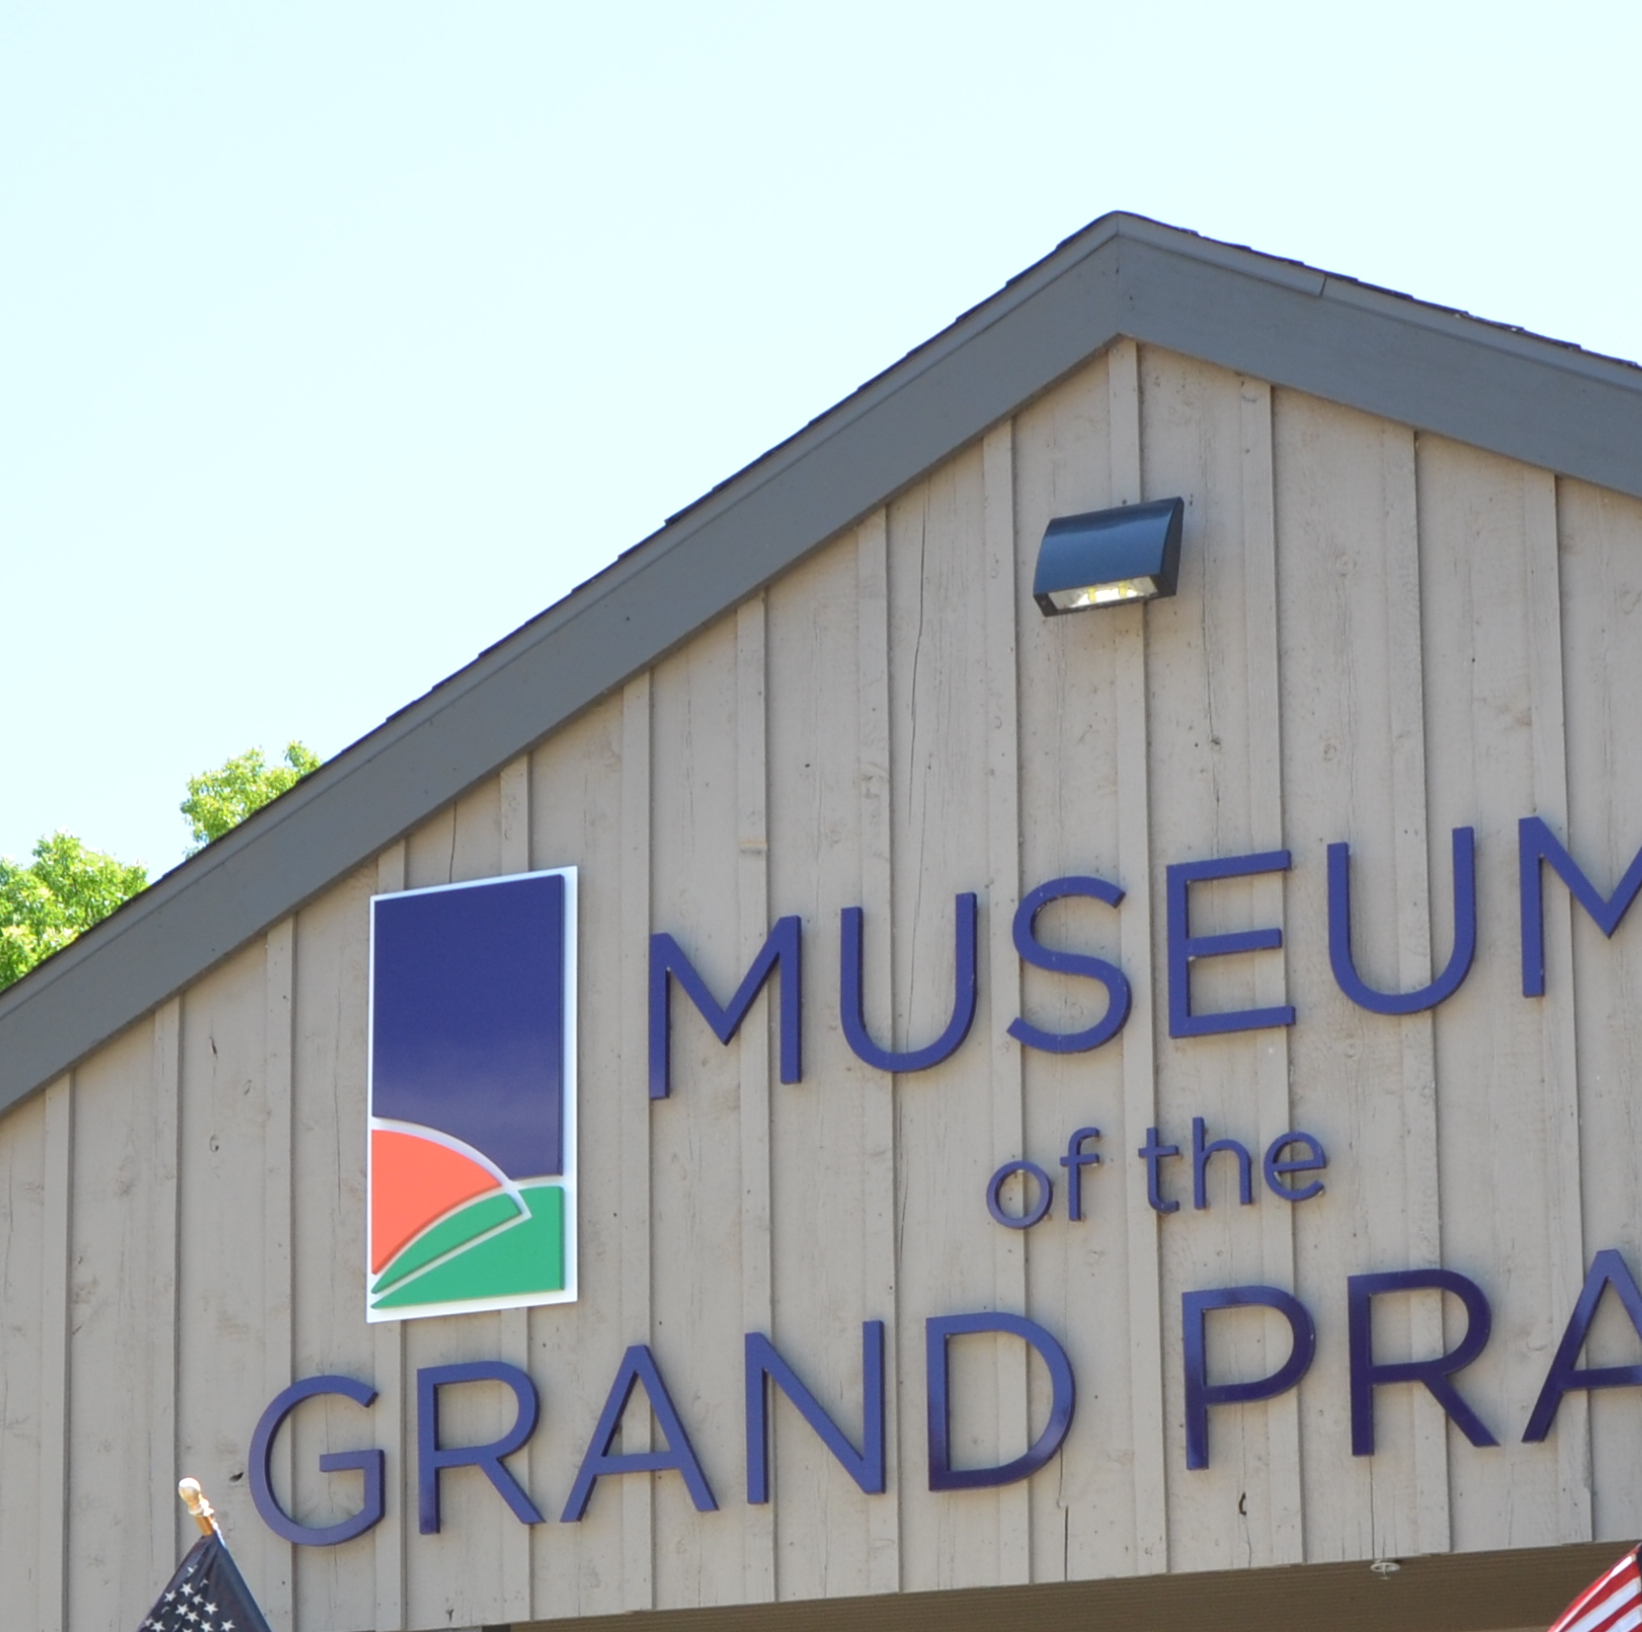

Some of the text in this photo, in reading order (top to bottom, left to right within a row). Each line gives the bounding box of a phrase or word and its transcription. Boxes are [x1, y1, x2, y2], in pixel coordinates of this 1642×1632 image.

[985, 1115, 1329, 1228] of the
[247, 1306, 1077, 1547] GRAND
